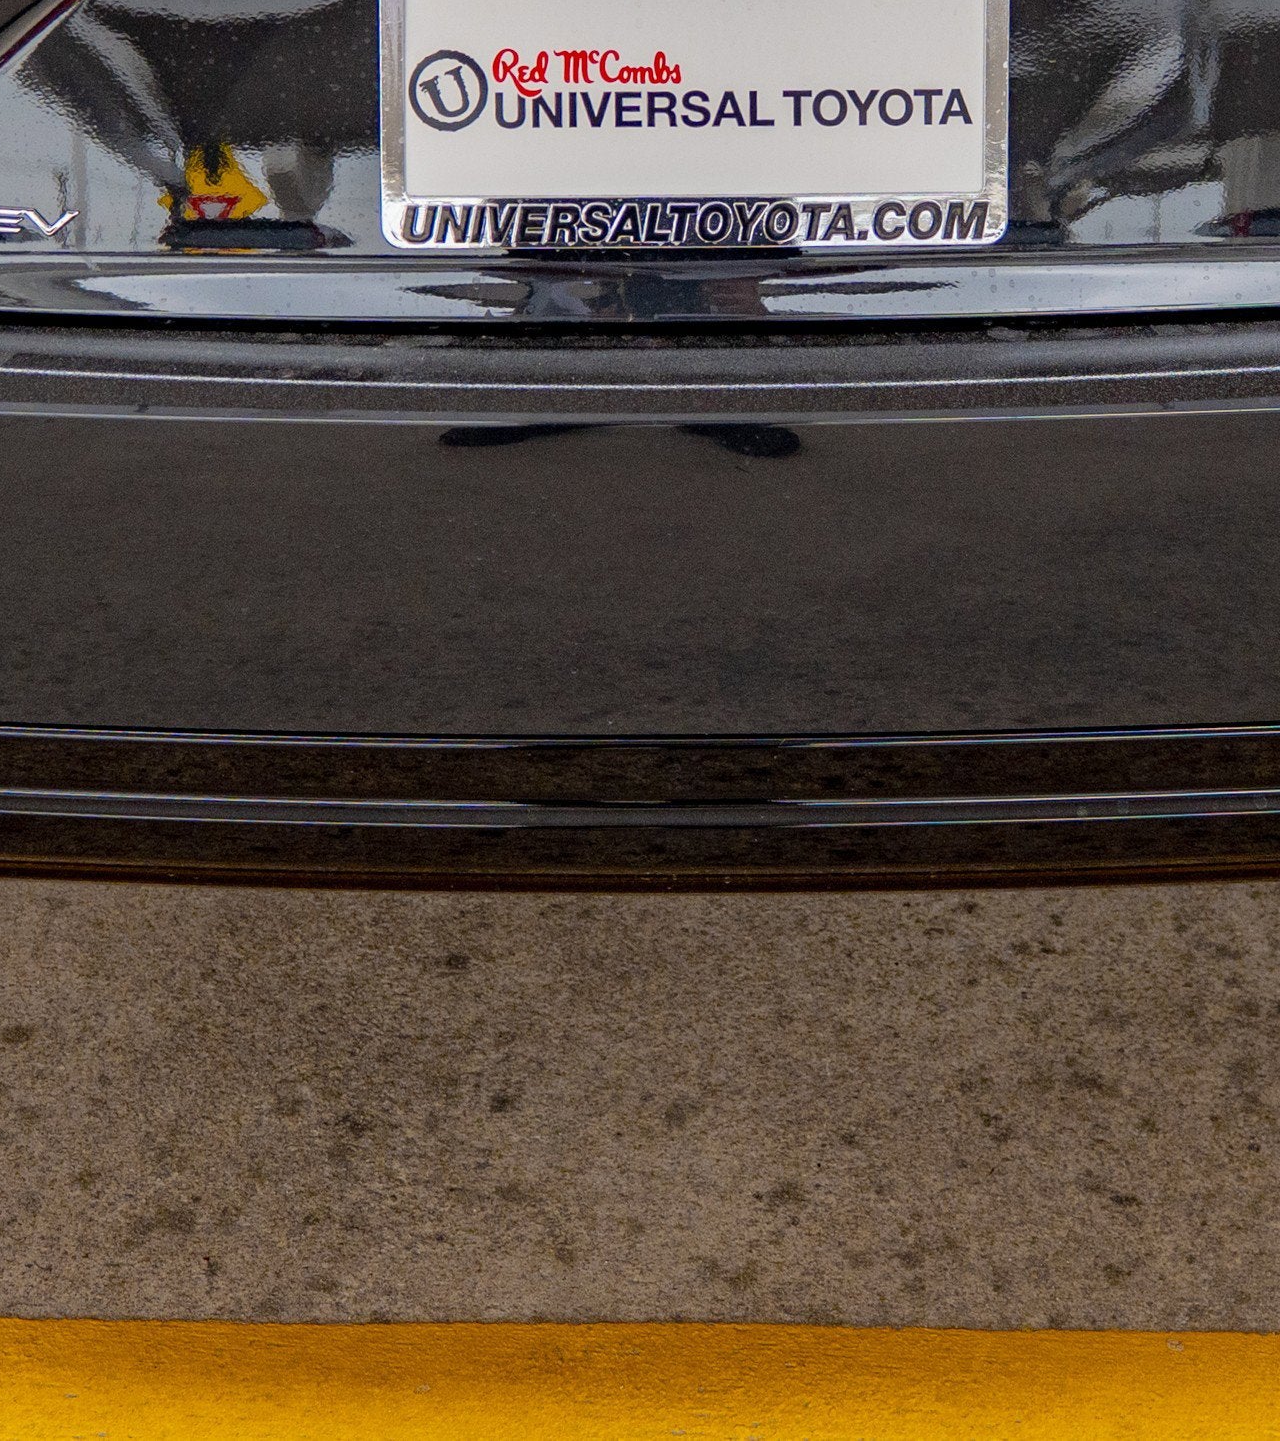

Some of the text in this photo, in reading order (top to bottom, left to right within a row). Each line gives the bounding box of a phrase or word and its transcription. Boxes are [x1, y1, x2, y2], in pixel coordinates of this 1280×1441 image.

[492, 48, 682, 98] Red McCombs
[494, 88, 973, 129] UNIVERSAL TOYOTA
[401, 200, 989, 247] UNIVERSALTOYOTA.COM
